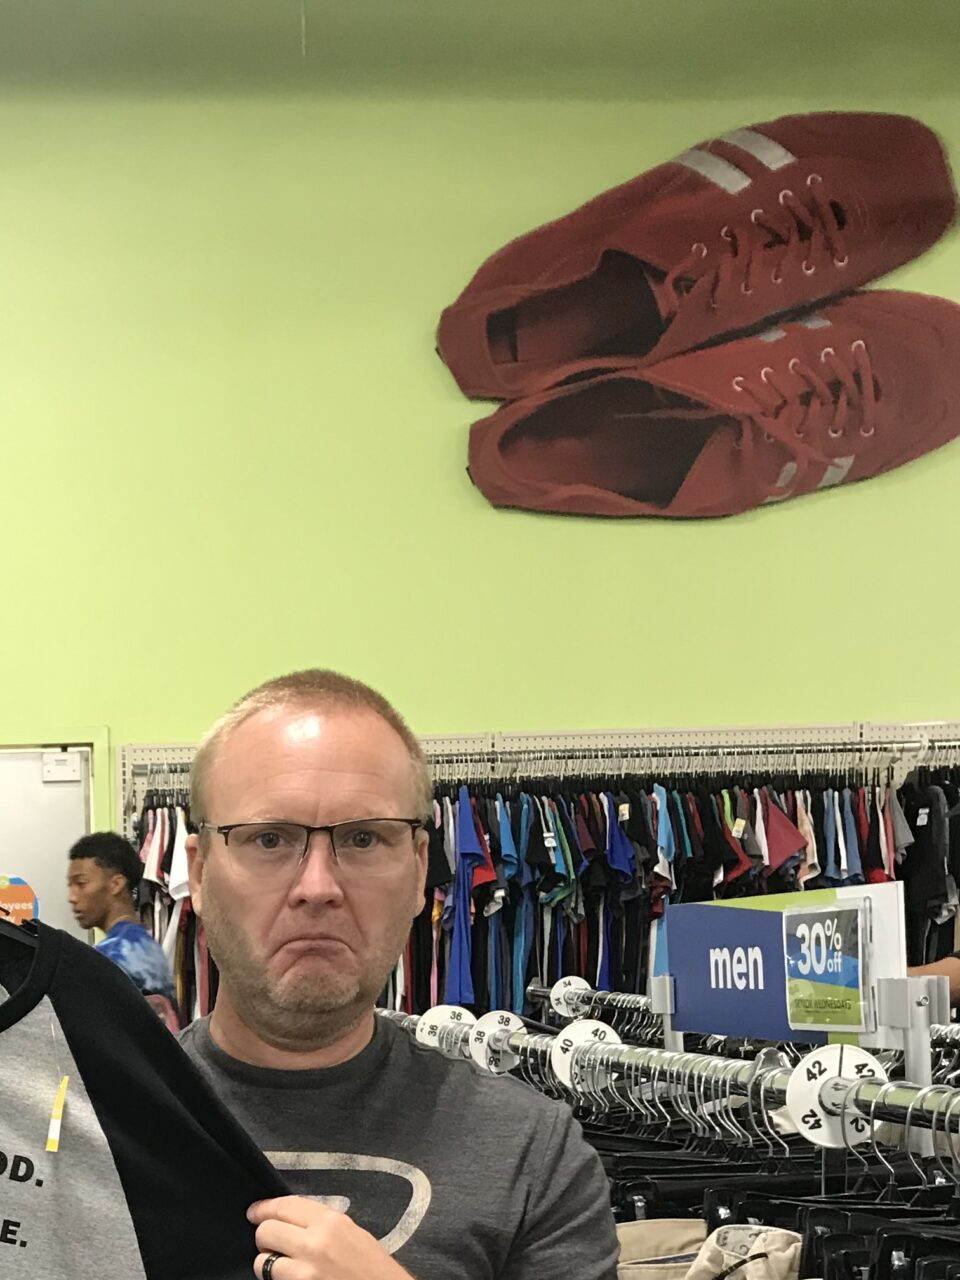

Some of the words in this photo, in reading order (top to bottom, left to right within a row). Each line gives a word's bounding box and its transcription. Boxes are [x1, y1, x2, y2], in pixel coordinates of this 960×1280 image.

[795, 918, 842, 975] 30%
[827, 951, 842, 973] off
[709, 945, 765, 990] men
[450, 1011, 462, 1021] 36
[497, 1015, 511, 1026] 38
[474, 1030, 486, 1044] 38
[591, 1027, 606, 1041] 40
[559, 1038, 574, 1055] 40
[806, 1060, 827, 1082] 42
[854, 1063, 876, 1079] 42
[801, 1109, 822, 1130] 42
